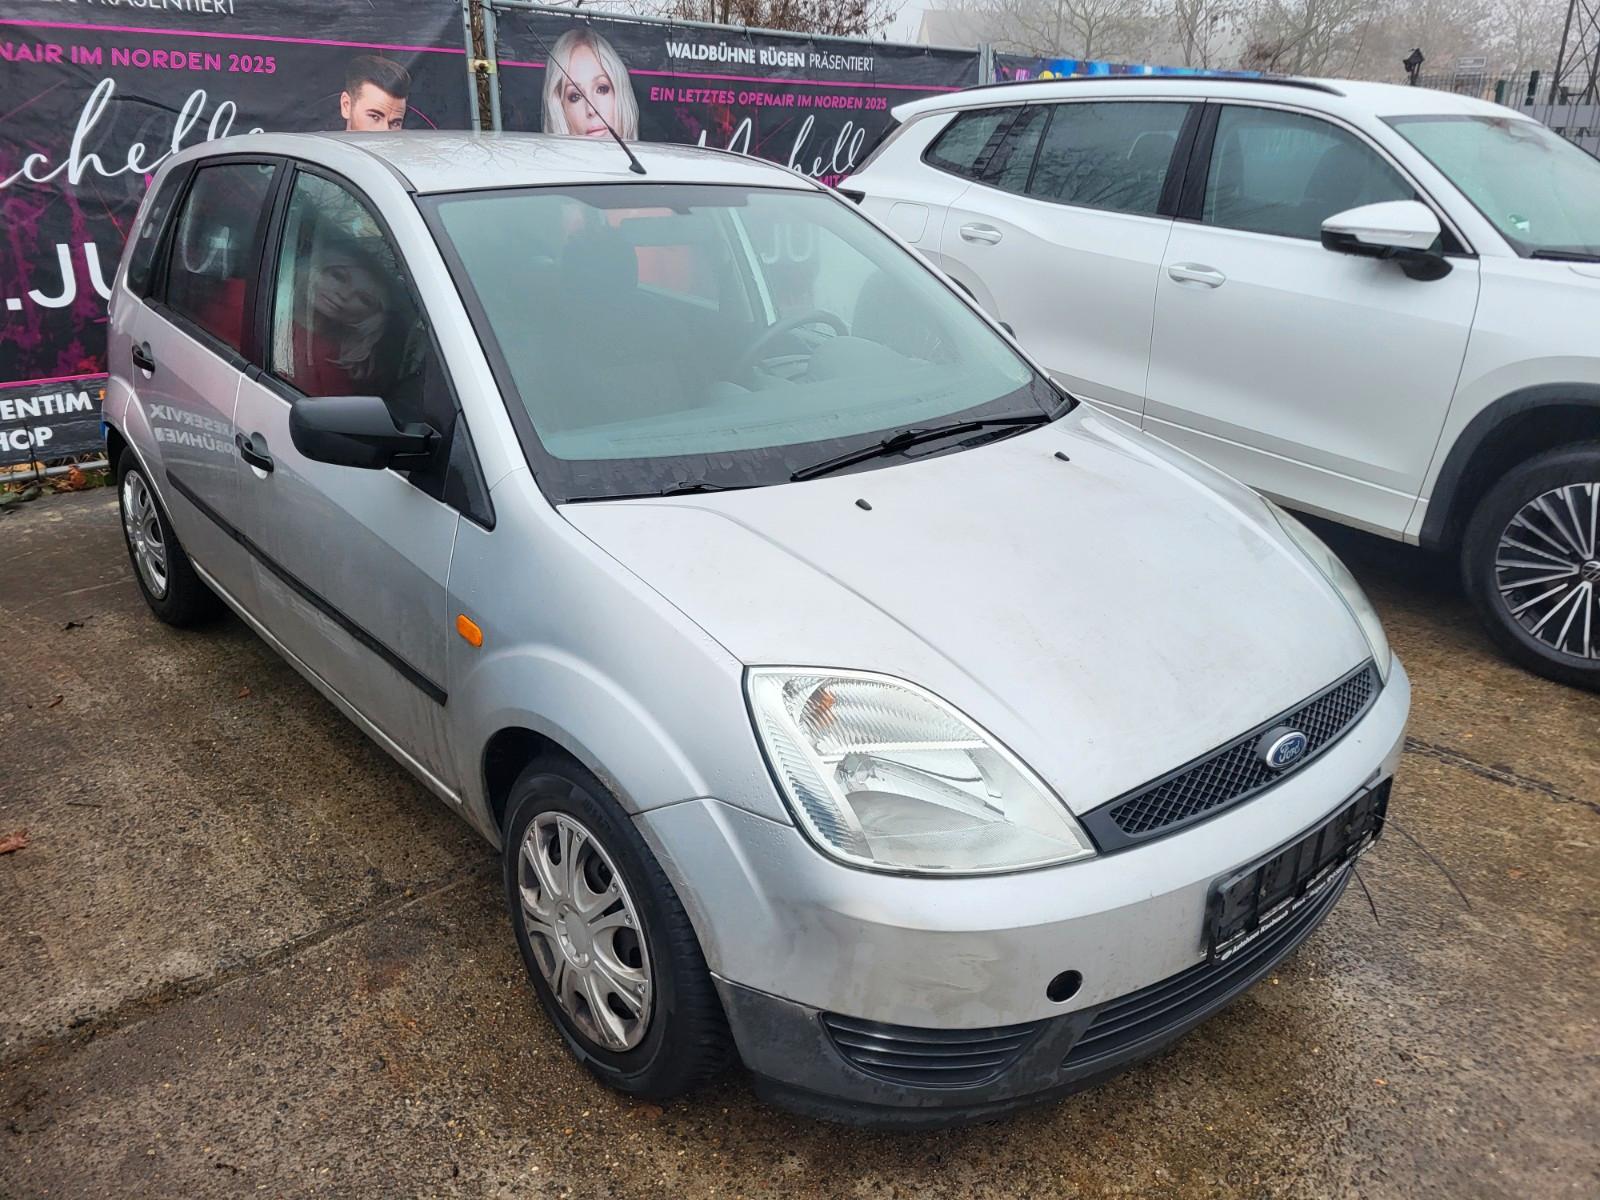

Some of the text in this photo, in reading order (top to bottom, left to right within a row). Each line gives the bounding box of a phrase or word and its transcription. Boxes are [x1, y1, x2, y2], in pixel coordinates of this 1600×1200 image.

[71, 45, 103, 65] IM
[111, 47, 222, 72] NORDEN
[228, 54, 276, 74] 2025
[666, 41, 874, 72] WALDBÜHNE RÜGEN PRÄSENTIERT
[650, 86, 887, 110] EIN LETZTES OPENAIR IM NORDEN 2025
[0, 391, 93, 420] ENTIM
[1278, 739, 1301, 763] Ford
